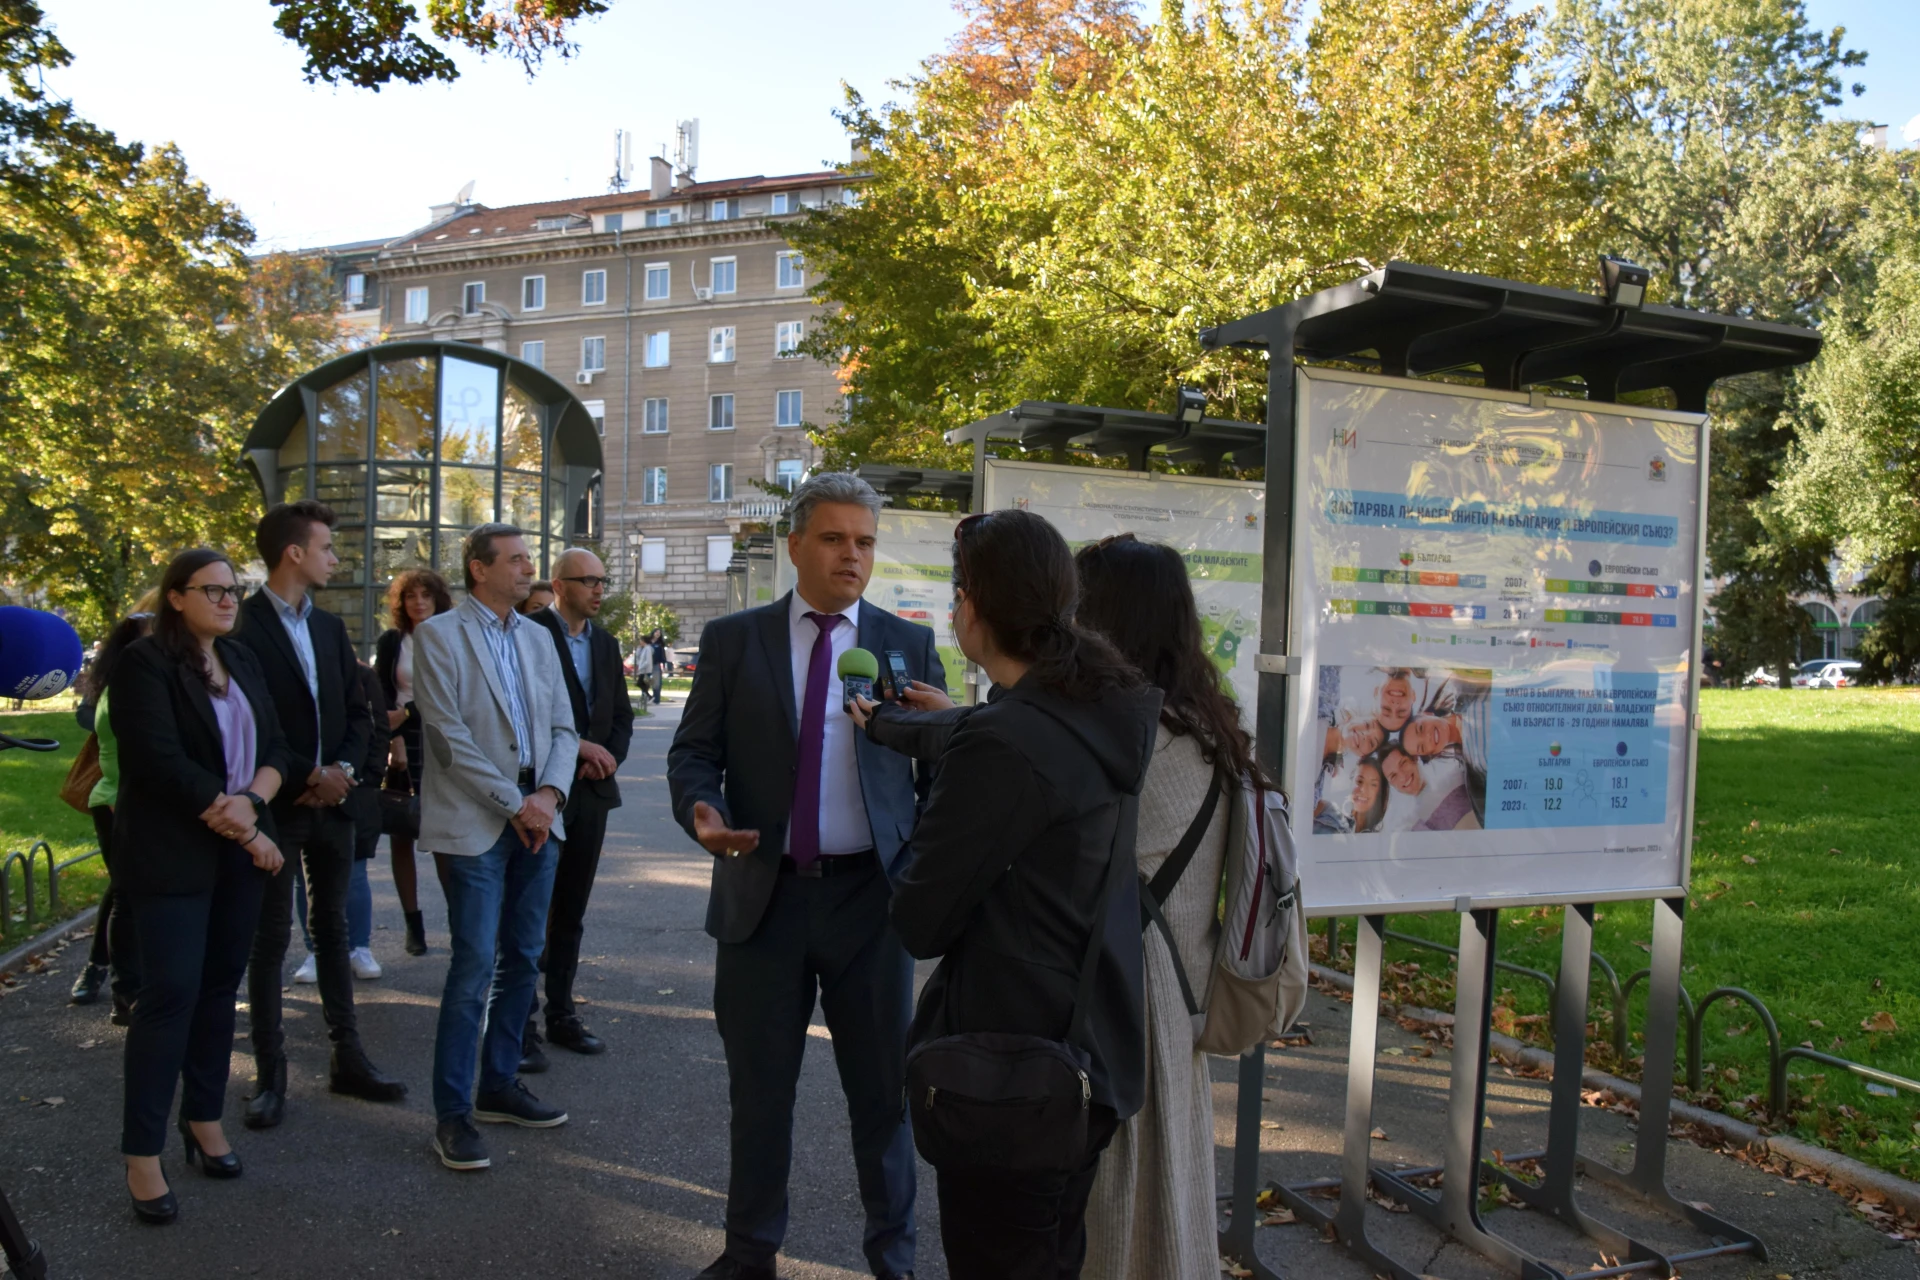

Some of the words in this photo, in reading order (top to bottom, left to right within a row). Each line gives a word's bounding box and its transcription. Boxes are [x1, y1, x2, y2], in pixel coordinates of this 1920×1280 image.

[1330, 499, 1395, 519] ЗАСТАРЯВА
[1573, 517, 1640, 537] ЕВРОПЕЙСКИЯ
[1642, 524, 1674, 540] СЪЮЗ?
[1193, 554, 1203, 564] СА
[1204, 555, 1249, 567] МЛАДЕЖИТЕ
[1604, 563, 1641, 575] ЕВРОПЕЙСКИ
[1504, 577, 1523, 588] 2007
[14, 675, 31, 690] NEWS
[1537, 688, 1576, 700] БЪЛГАРИЯ,
[1503, 702, 1525, 713] СЪЮЗ
[1526, 702, 1585, 713] ОТНОСИТЕЛНИЯТ
[1586, 703, 1602, 714] ДЯЛ
[1604, 703, 1613, 713] НА
[1614, 703, 1656, 715] МЛАДЕЖИТЕ
[1511, 717, 1521, 727] НА
[1523, 717, 1555, 727] ВЪЗРАСТ
[1557, 717, 1565, 727] 16
[1572, 717, 1580, 727] 29
[1582, 717, 1610, 729] ГОДИНИ
[1611, 717, 1649, 727] НАМАЛЯВА
[1538, 757, 1571, 767] БЪЛГАРИЯ
[1593, 757, 1630, 768] ЕВРОПЕЙСКИ
[1631, 758, 1649, 767] СЪЮЗ
[1503, 779, 1523, 790] 2007
[1524, 782, 1529, 790] г.
[1544, 777, 1563, 791] 19.0
[1612, 776, 1628, 789] 18.1
[1501, 800, 1521, 811] 2023
[1522, 802, 1528, 810] г.
[1543, 797, 1562, 811] 12.2
[1611, 796, 1628, 809] 15.2
